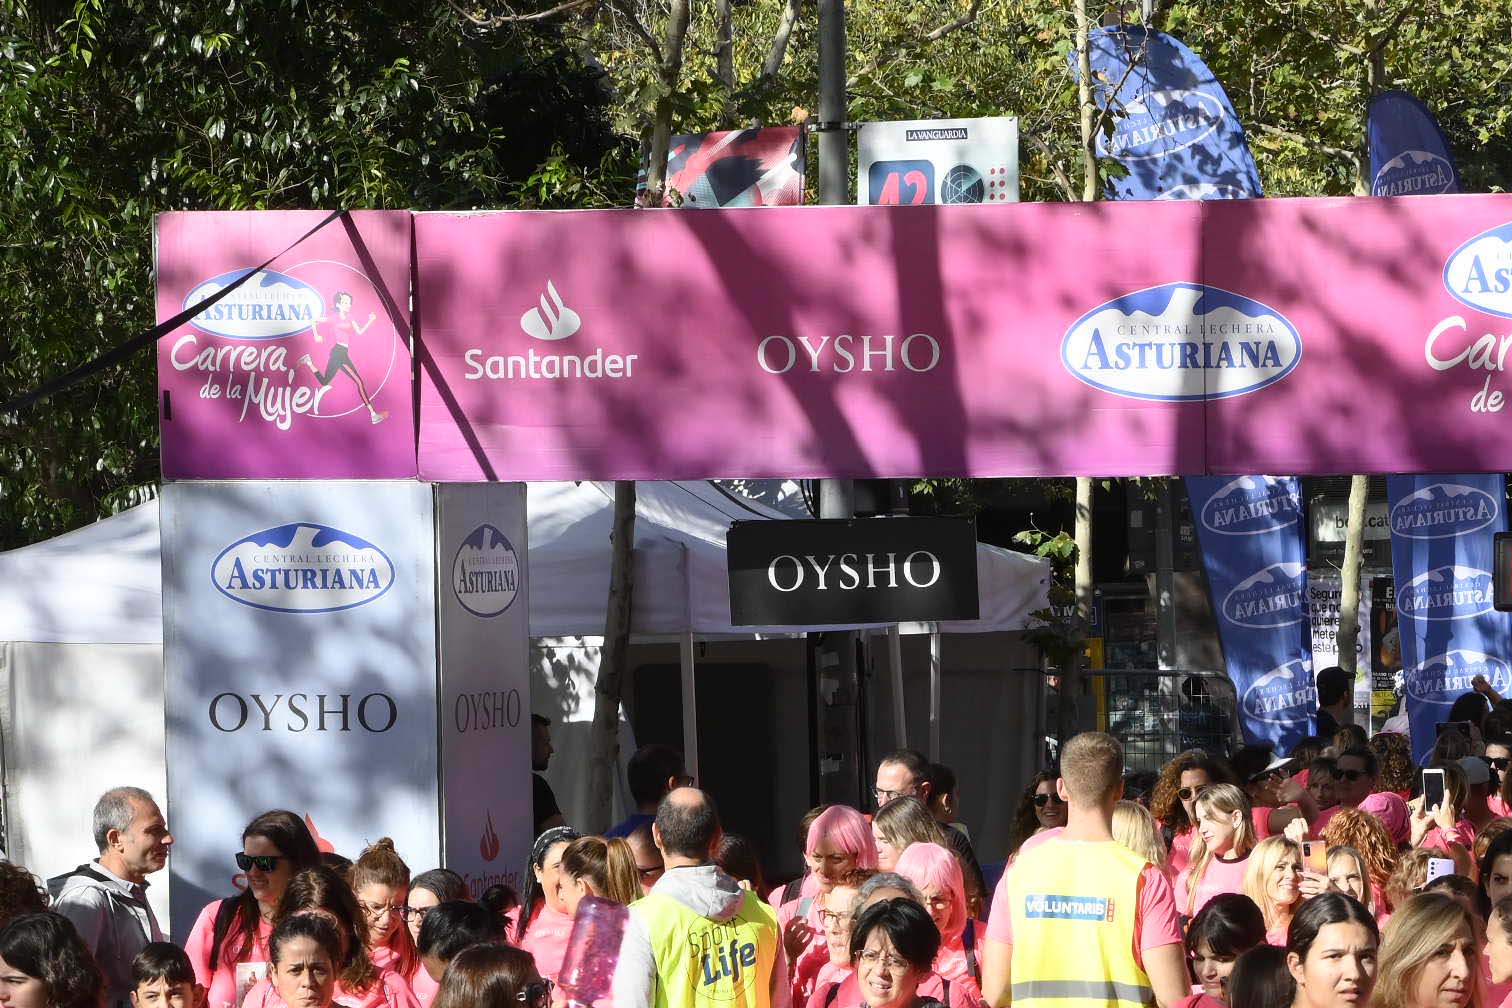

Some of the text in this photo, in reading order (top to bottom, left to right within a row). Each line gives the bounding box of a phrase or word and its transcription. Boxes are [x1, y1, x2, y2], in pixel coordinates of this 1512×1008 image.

[919, 128, 967, 141] VANGUARDIA
[1080, 327, 1284, 371] ASTURIANA
[1117, 323, 1275, 336] CENTRAL LECHERA
[170, 334, 288, 372] Carrera
[464, 347, 639, 380] Santander
[756, 333, 941, 374] OYSHO
[200, 368, 333, 431] de la Mujer
[1470, 374, 1505, 413] de
[225, 556, 382, 591] ASTURIANA
[253, 553, 376, 564] CENTRAL LECHERA
[458, 560, 516, 595] ASTURIANA
[767, 550, 941, 592] OYSHO
[207, 692, 399, 733] OYSHO
[455, 687, 521, 733] OYSHO
[1026, 896, 1105, 916] VOLUNTARIS
[688, 915, 741, 958] Sport
[701, 938, 757, 987] Life
